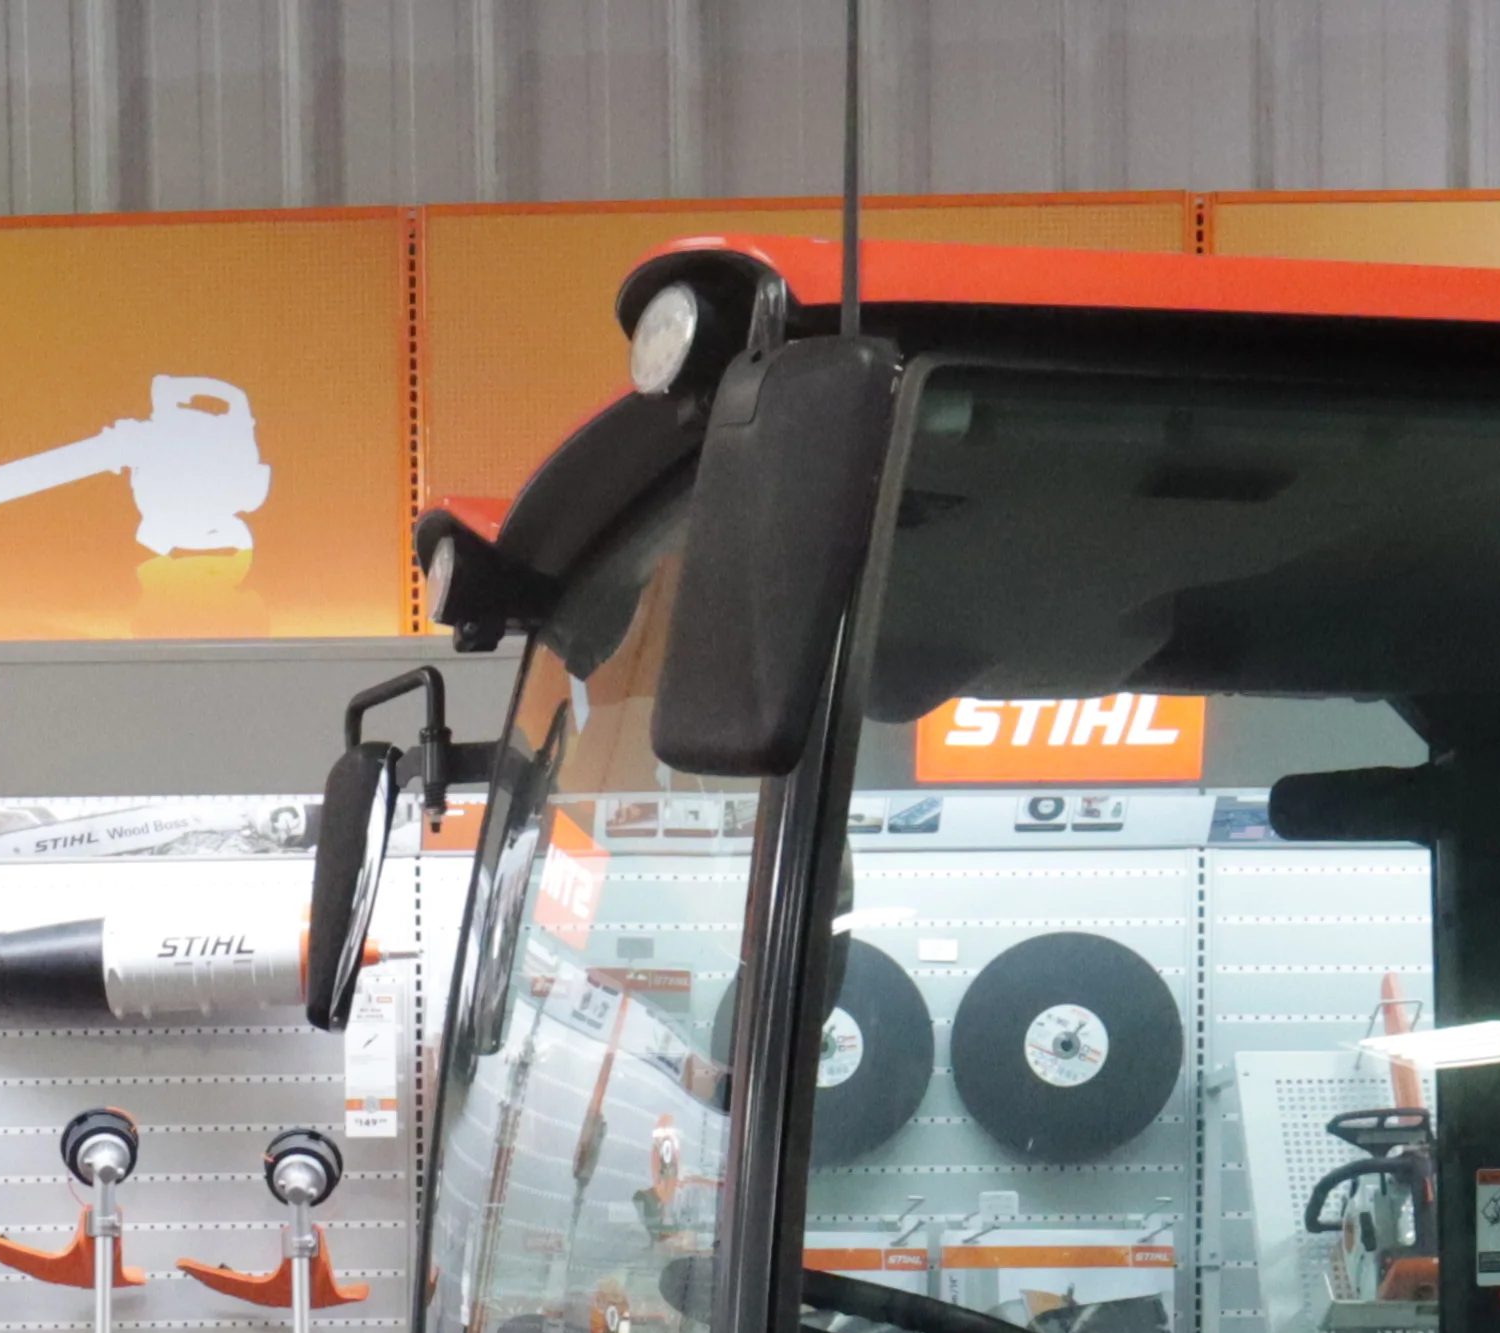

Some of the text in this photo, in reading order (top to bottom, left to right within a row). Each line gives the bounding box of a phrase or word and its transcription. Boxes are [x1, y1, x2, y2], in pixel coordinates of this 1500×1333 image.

[944, 694, 1181, 747] STIHL
[34, 817, 189, 852] STIHL Wood Boss
[156, 934, 255, 958] STIHL
[888, 1254, 924, 1266] STIHL
[1134, 1251, 1171, 1262] STIHL
